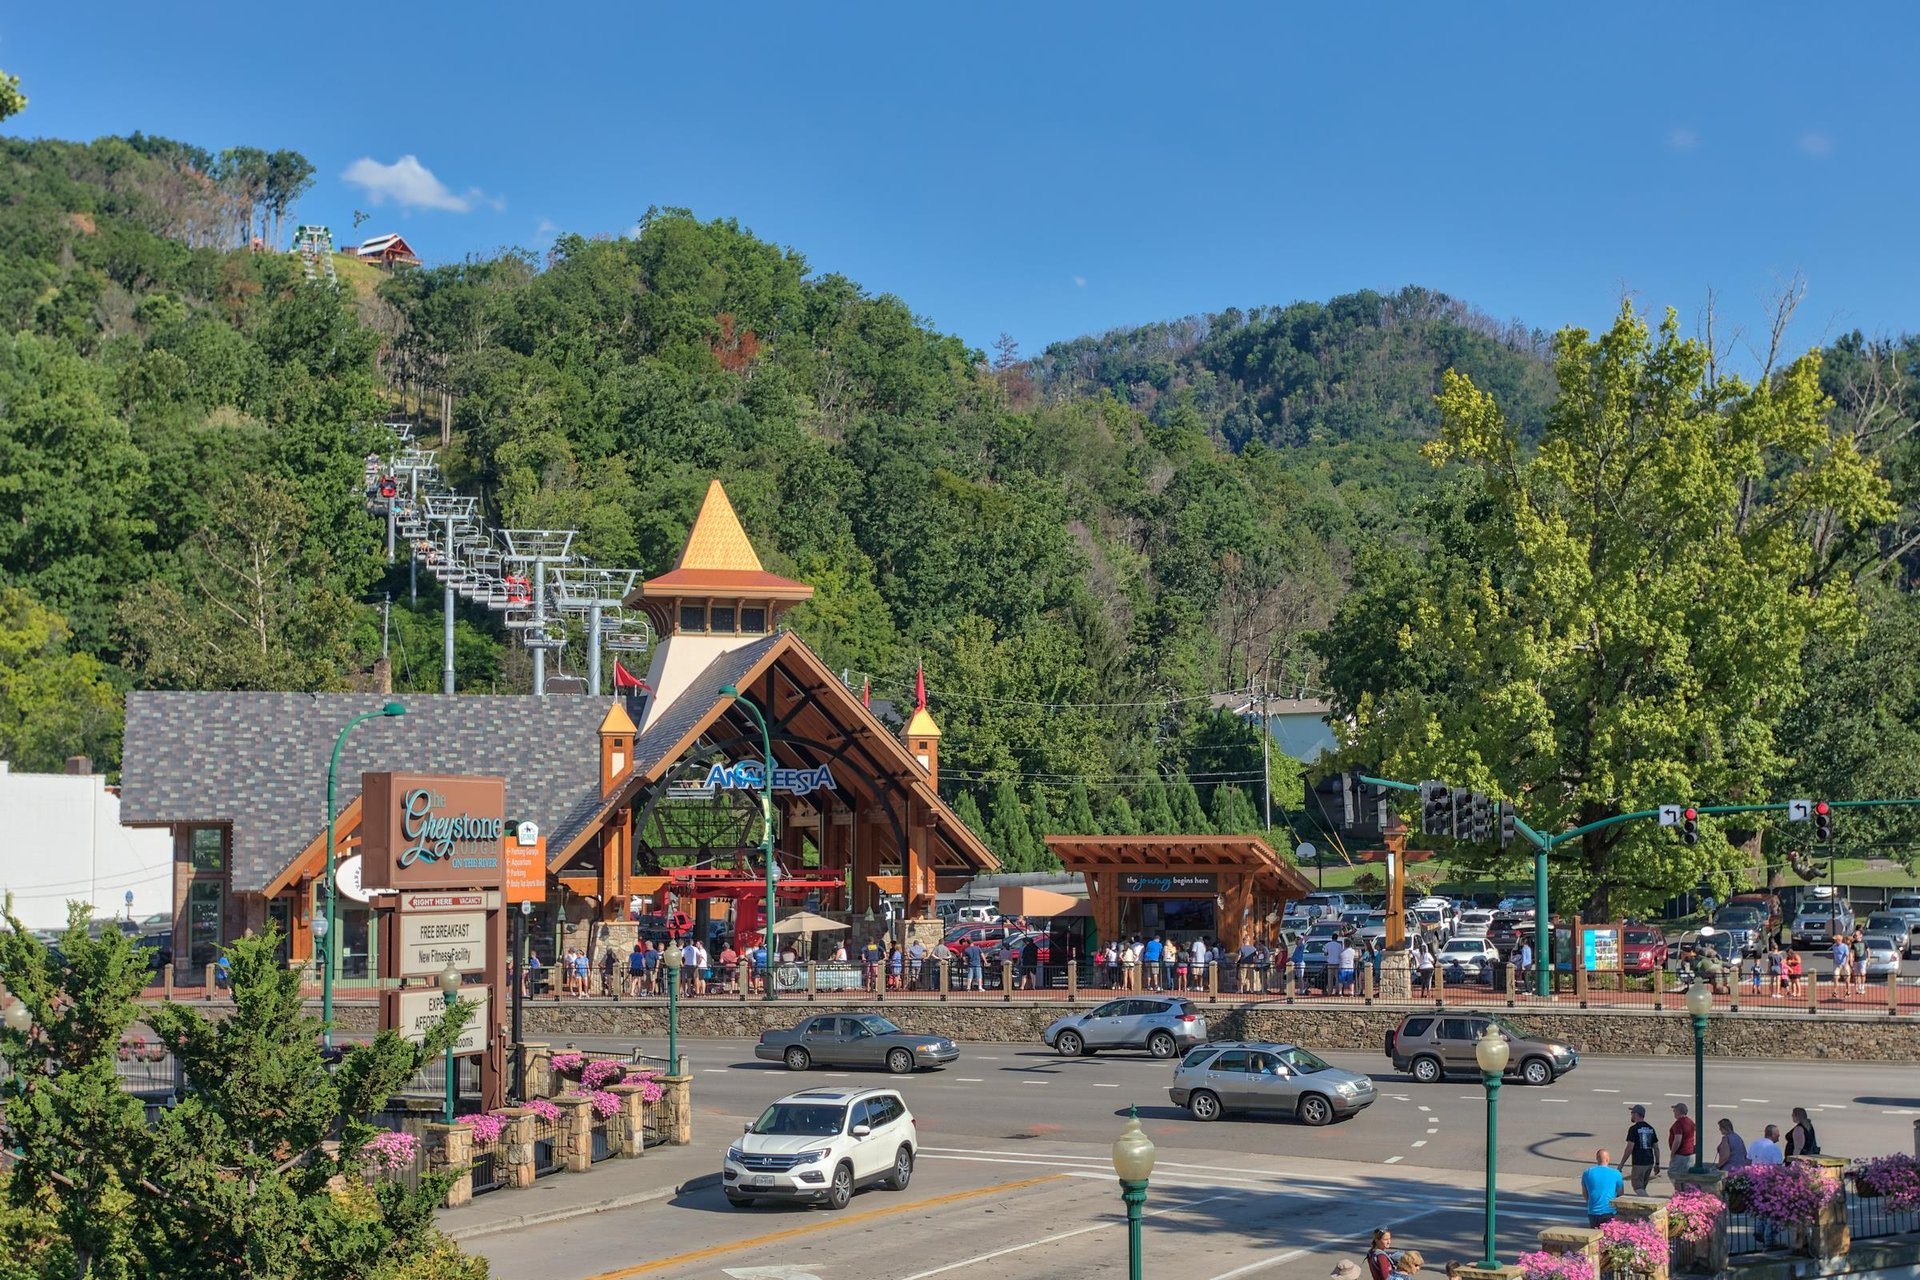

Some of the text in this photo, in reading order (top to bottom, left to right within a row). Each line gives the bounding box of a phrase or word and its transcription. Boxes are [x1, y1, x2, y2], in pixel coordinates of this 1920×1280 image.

[400, 789, 503, 867] Greystone
[1126, 876, 1209, 892] the journey begins here
[413, 896, 481, 906] RIGHT HERE VACANCY
[420, 923, 470, 939] FREE BREAKFAST
[418, 947, 471, 964] New Fitness Facility
